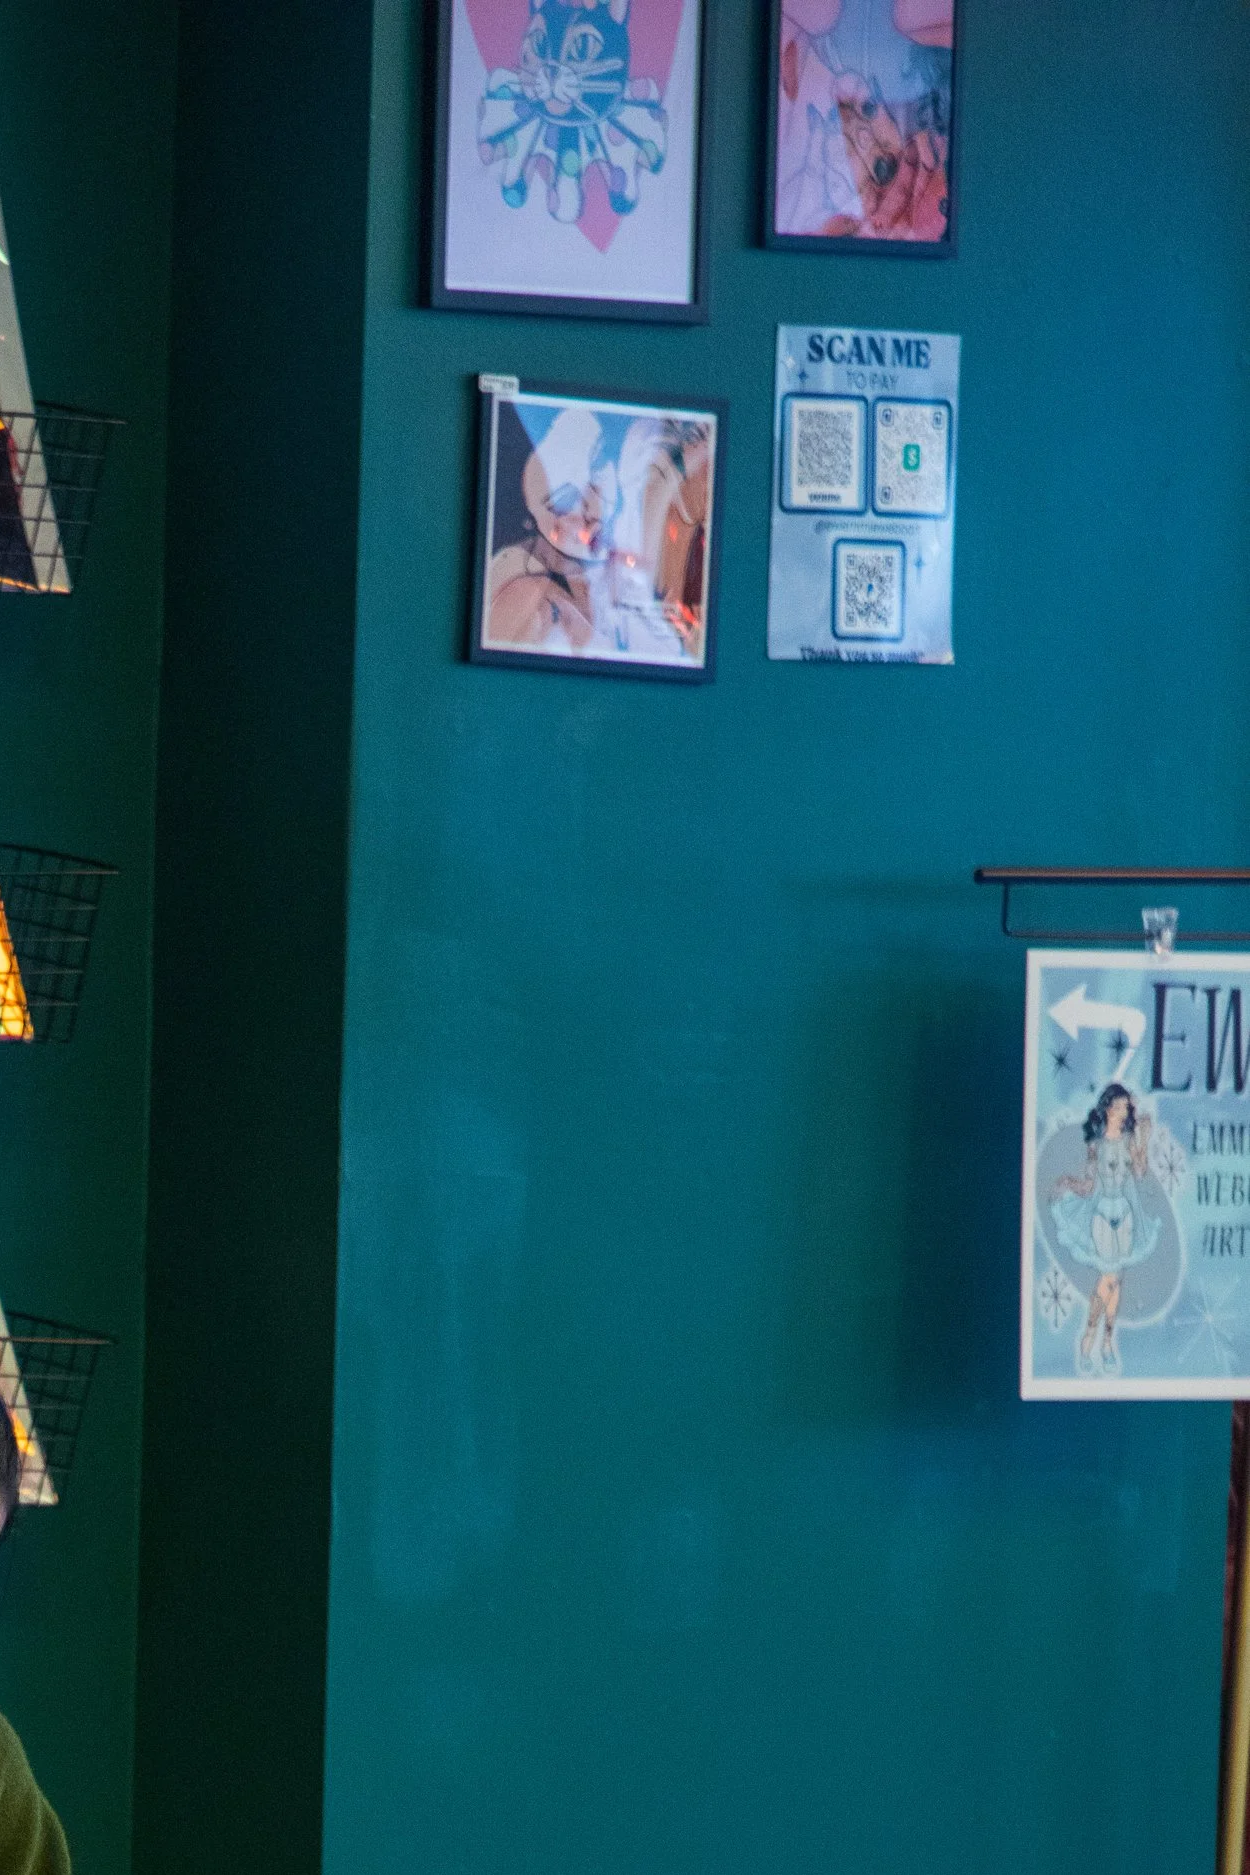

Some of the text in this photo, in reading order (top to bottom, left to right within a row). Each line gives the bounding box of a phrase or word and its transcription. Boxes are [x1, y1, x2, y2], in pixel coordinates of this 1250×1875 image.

[807, 334, 931, 370] SCAN ME
[847, 370, 899, 391] TO PAY
[1191, 1121, 1250, 1155] EMM
[1197, 1171, 1250, 1207] WEB
[1202, 1222, 1250, 1257] ART
